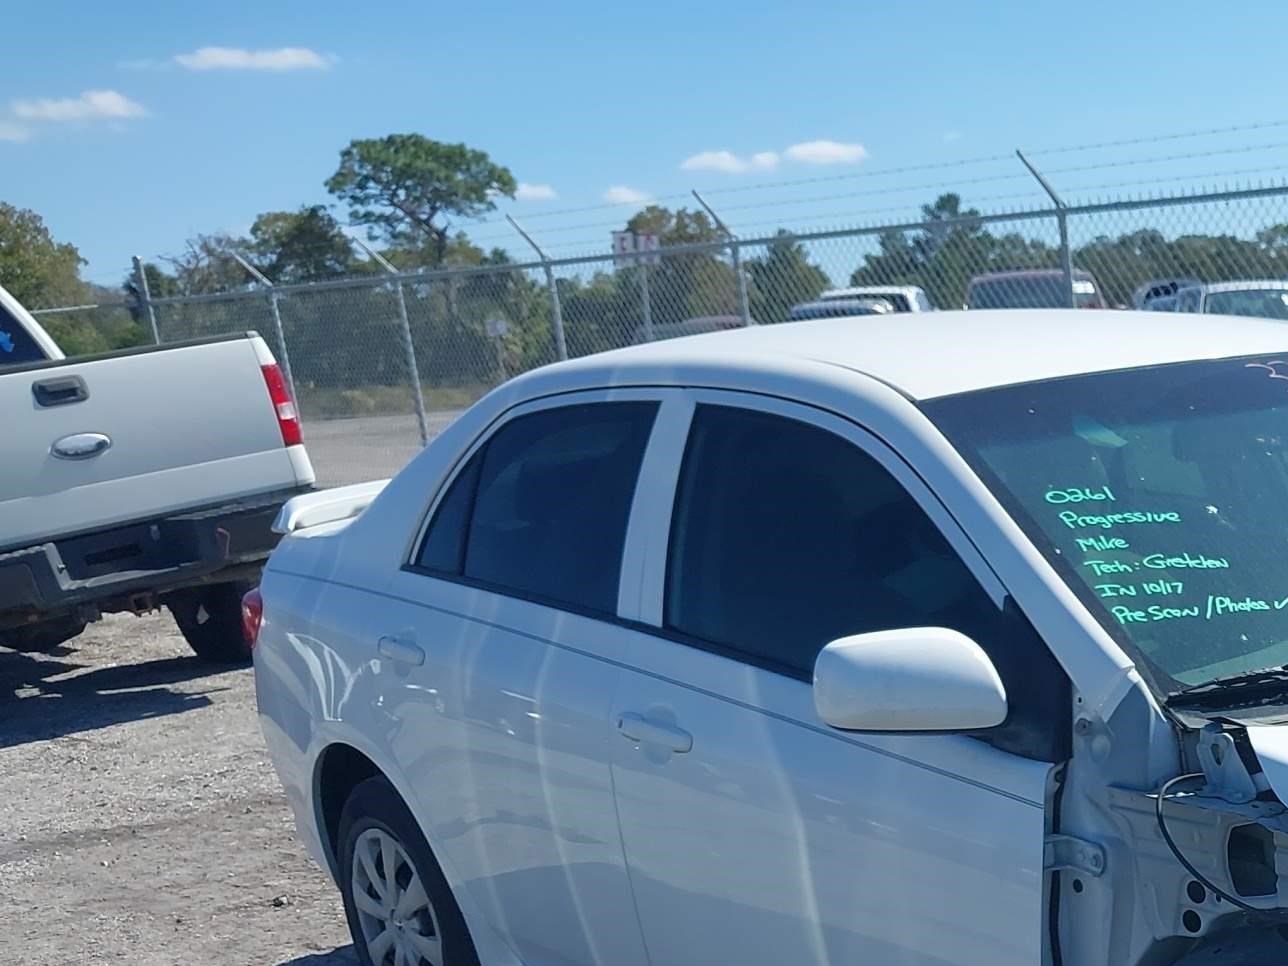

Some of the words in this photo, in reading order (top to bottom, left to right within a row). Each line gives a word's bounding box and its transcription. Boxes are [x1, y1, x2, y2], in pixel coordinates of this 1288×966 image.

[1045, 485, 1116, 504] 0261
[1058, 510, 1182, 529] Progressive
[1075, 535, 1130, 552] Mike
[1142, 579, 1184, 596] 10/17
